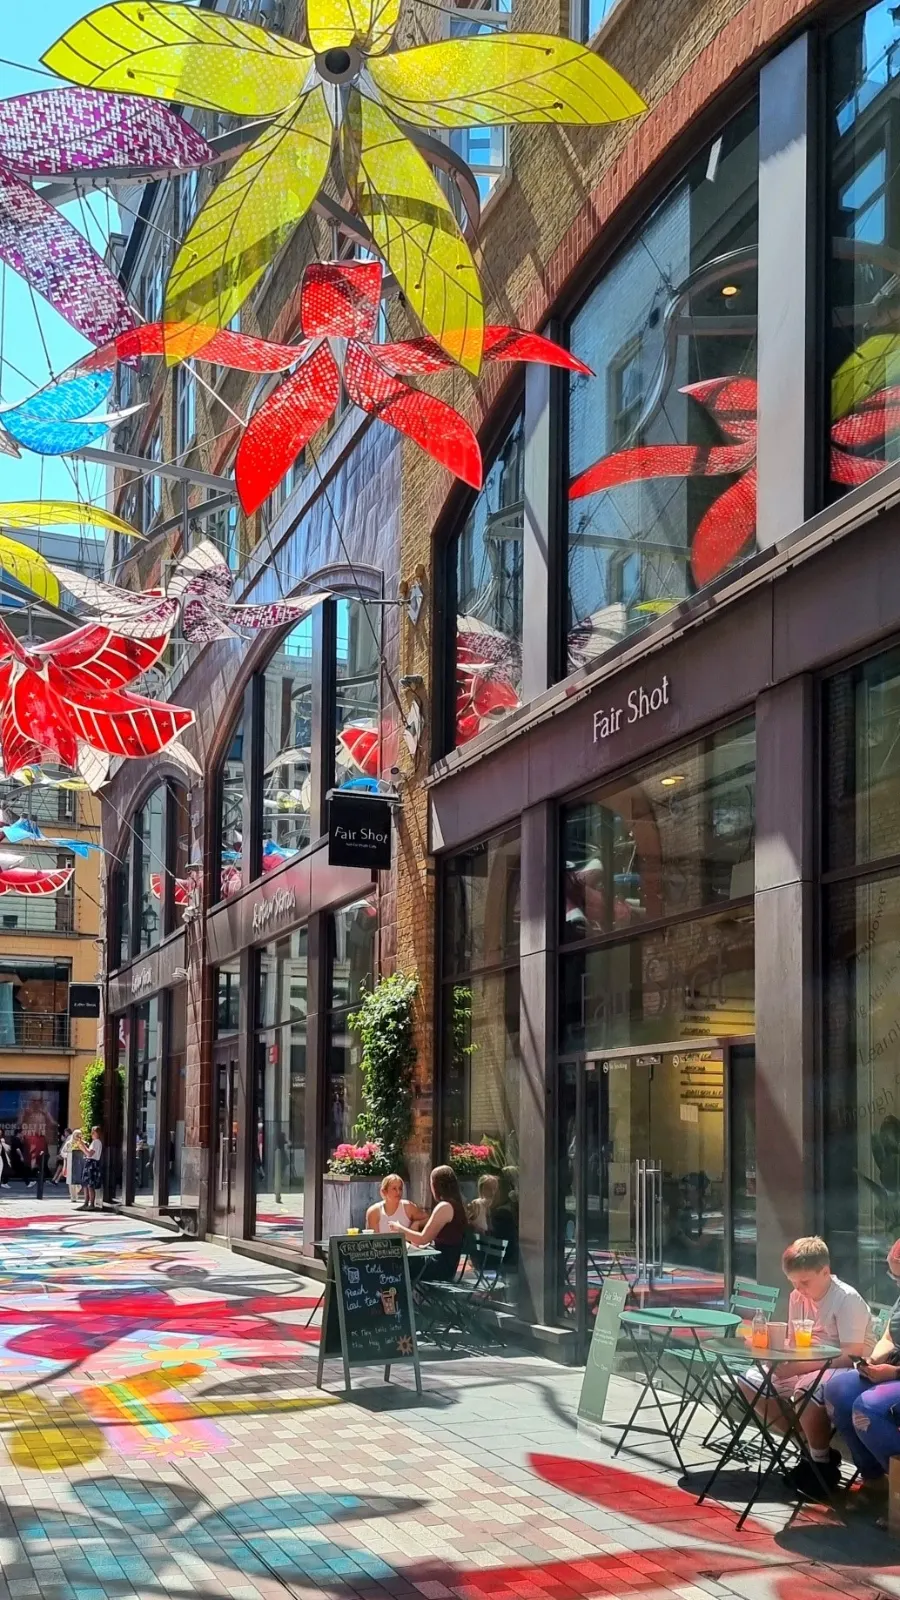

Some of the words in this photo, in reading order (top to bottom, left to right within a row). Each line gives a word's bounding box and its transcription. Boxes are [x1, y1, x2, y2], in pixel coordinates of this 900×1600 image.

[593, 707, 623, 743] Fair
[627, 675, 669, 723] Shot
[334, 826, 357, 840] Fair
[360, 828, 388, 844] Shot
